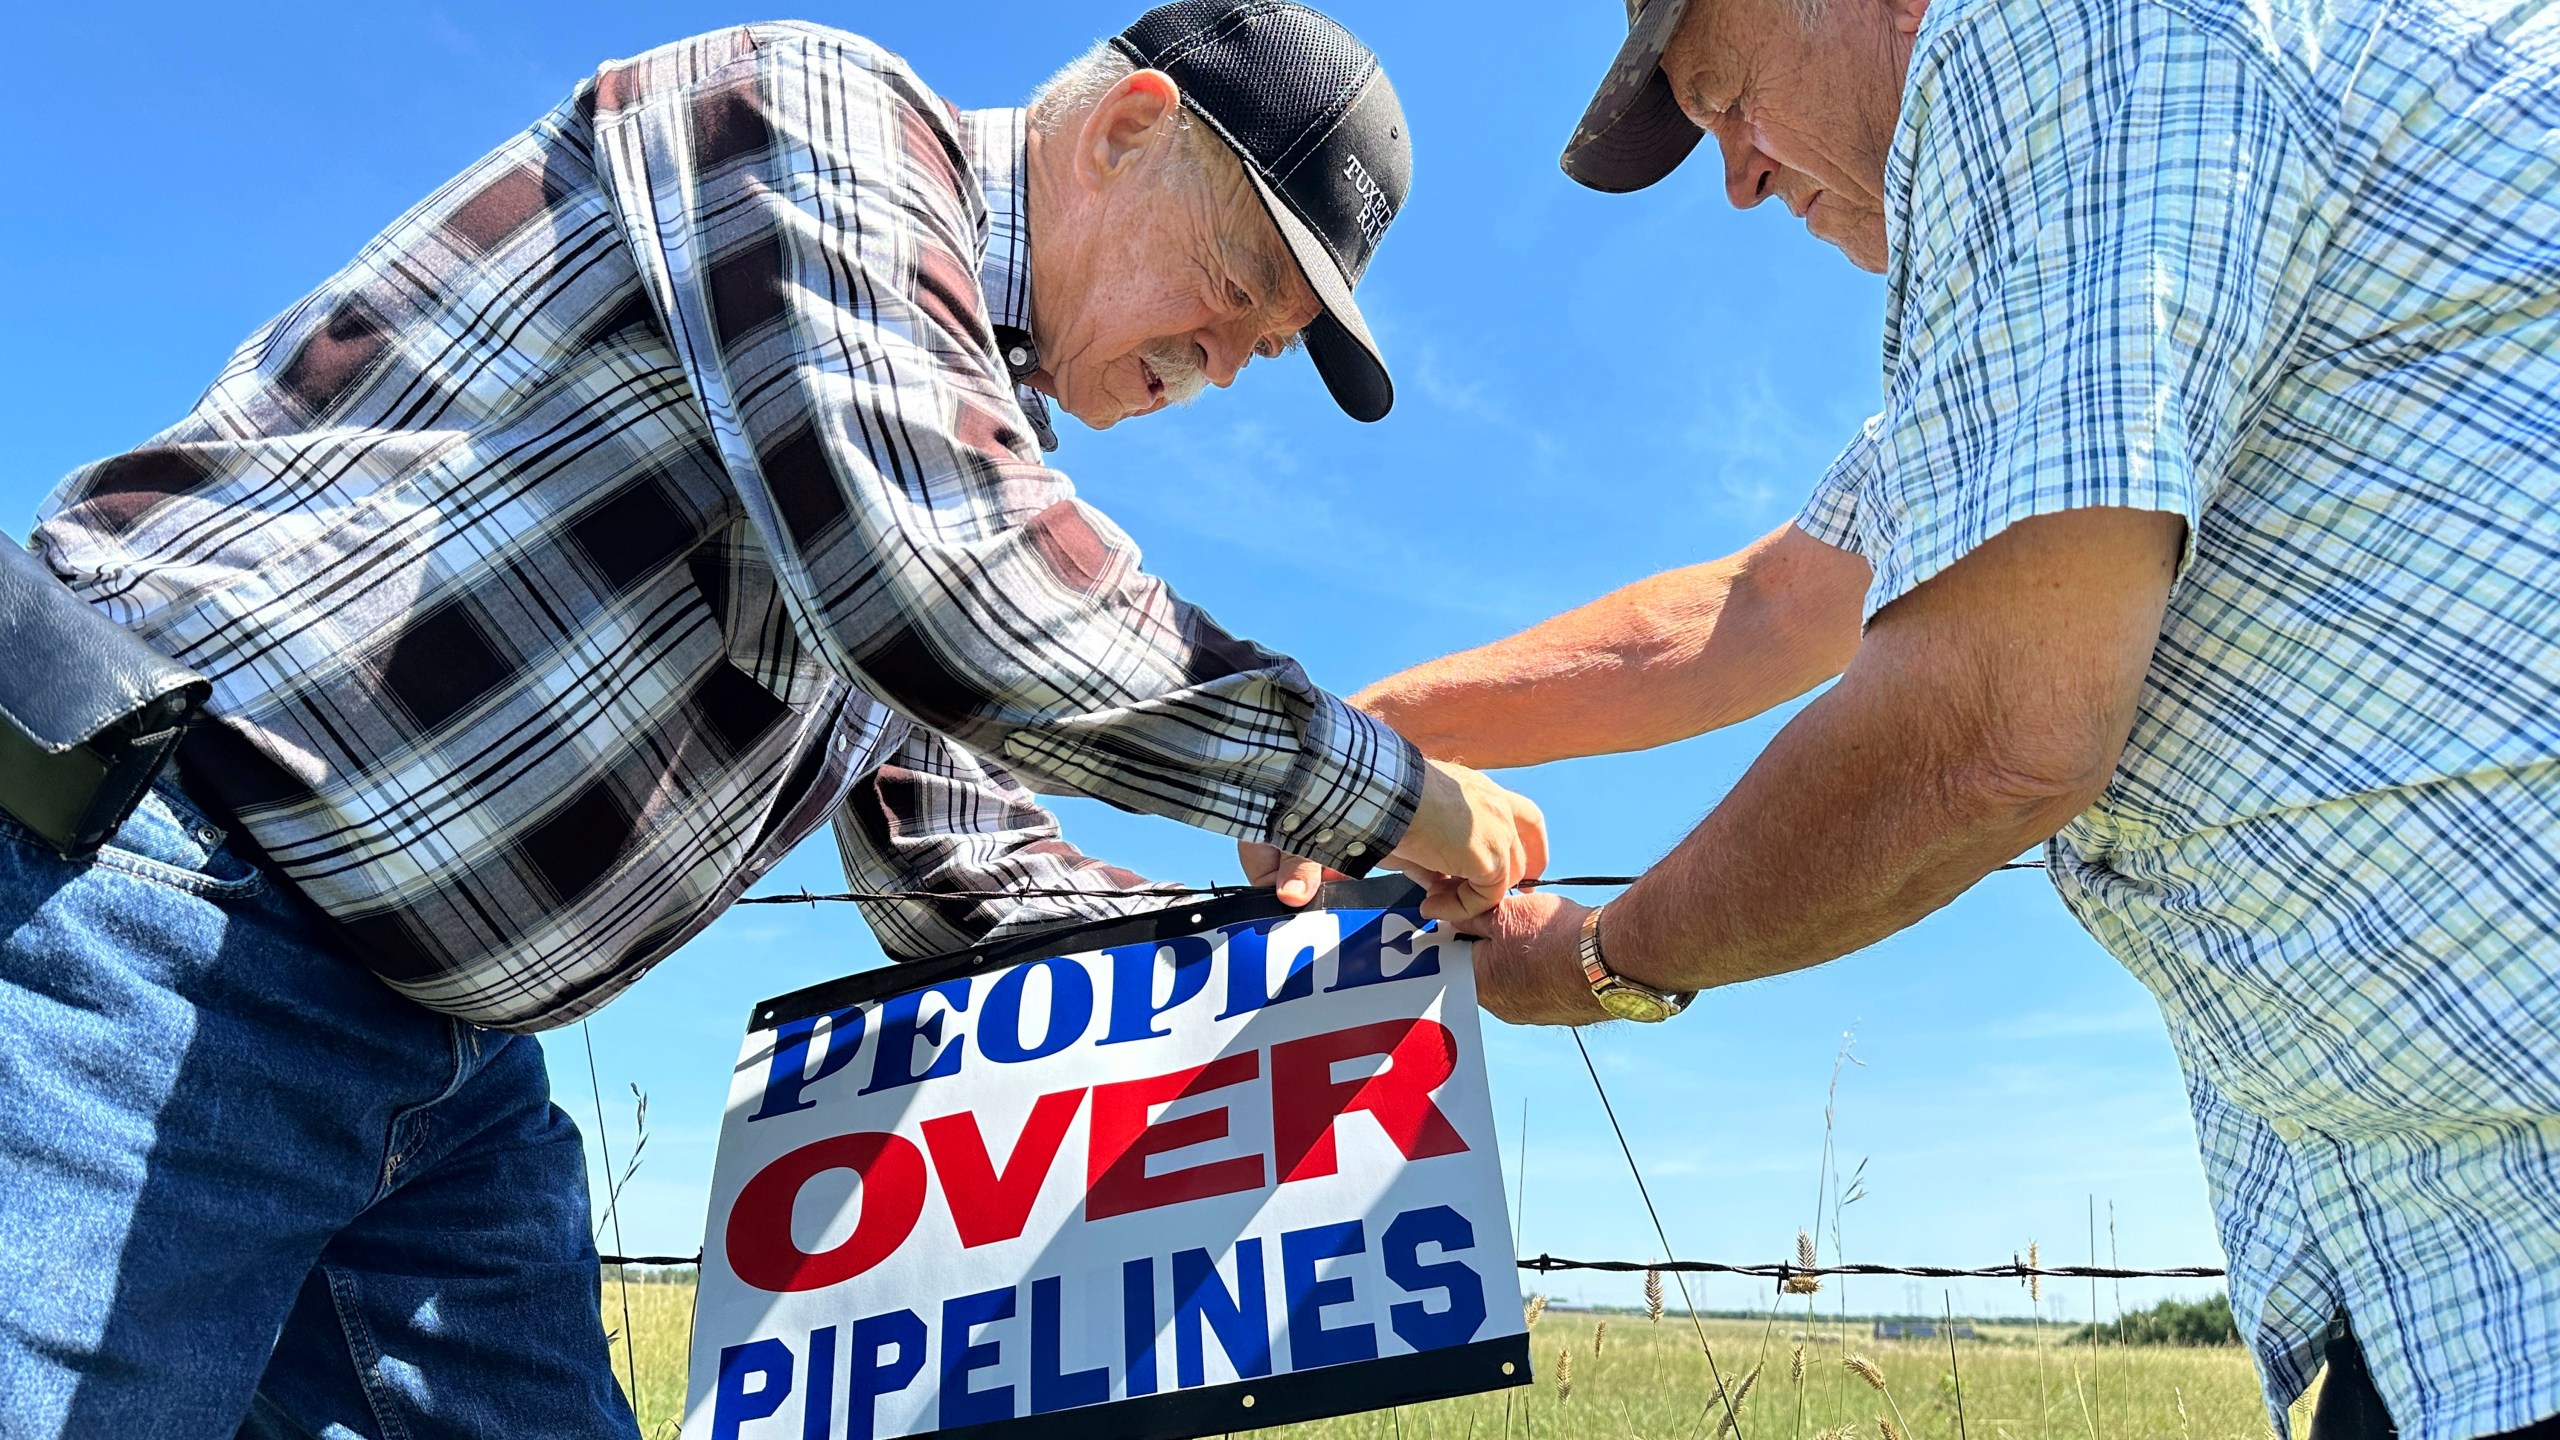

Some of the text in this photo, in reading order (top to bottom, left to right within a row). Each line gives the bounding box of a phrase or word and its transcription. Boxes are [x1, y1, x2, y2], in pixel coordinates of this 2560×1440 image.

[747, 908, 1441, 1123] PEOPLE
[725, 1017, 1471, 1293] OVER
[711, 1203, 1487, 1440] PIPELINES
